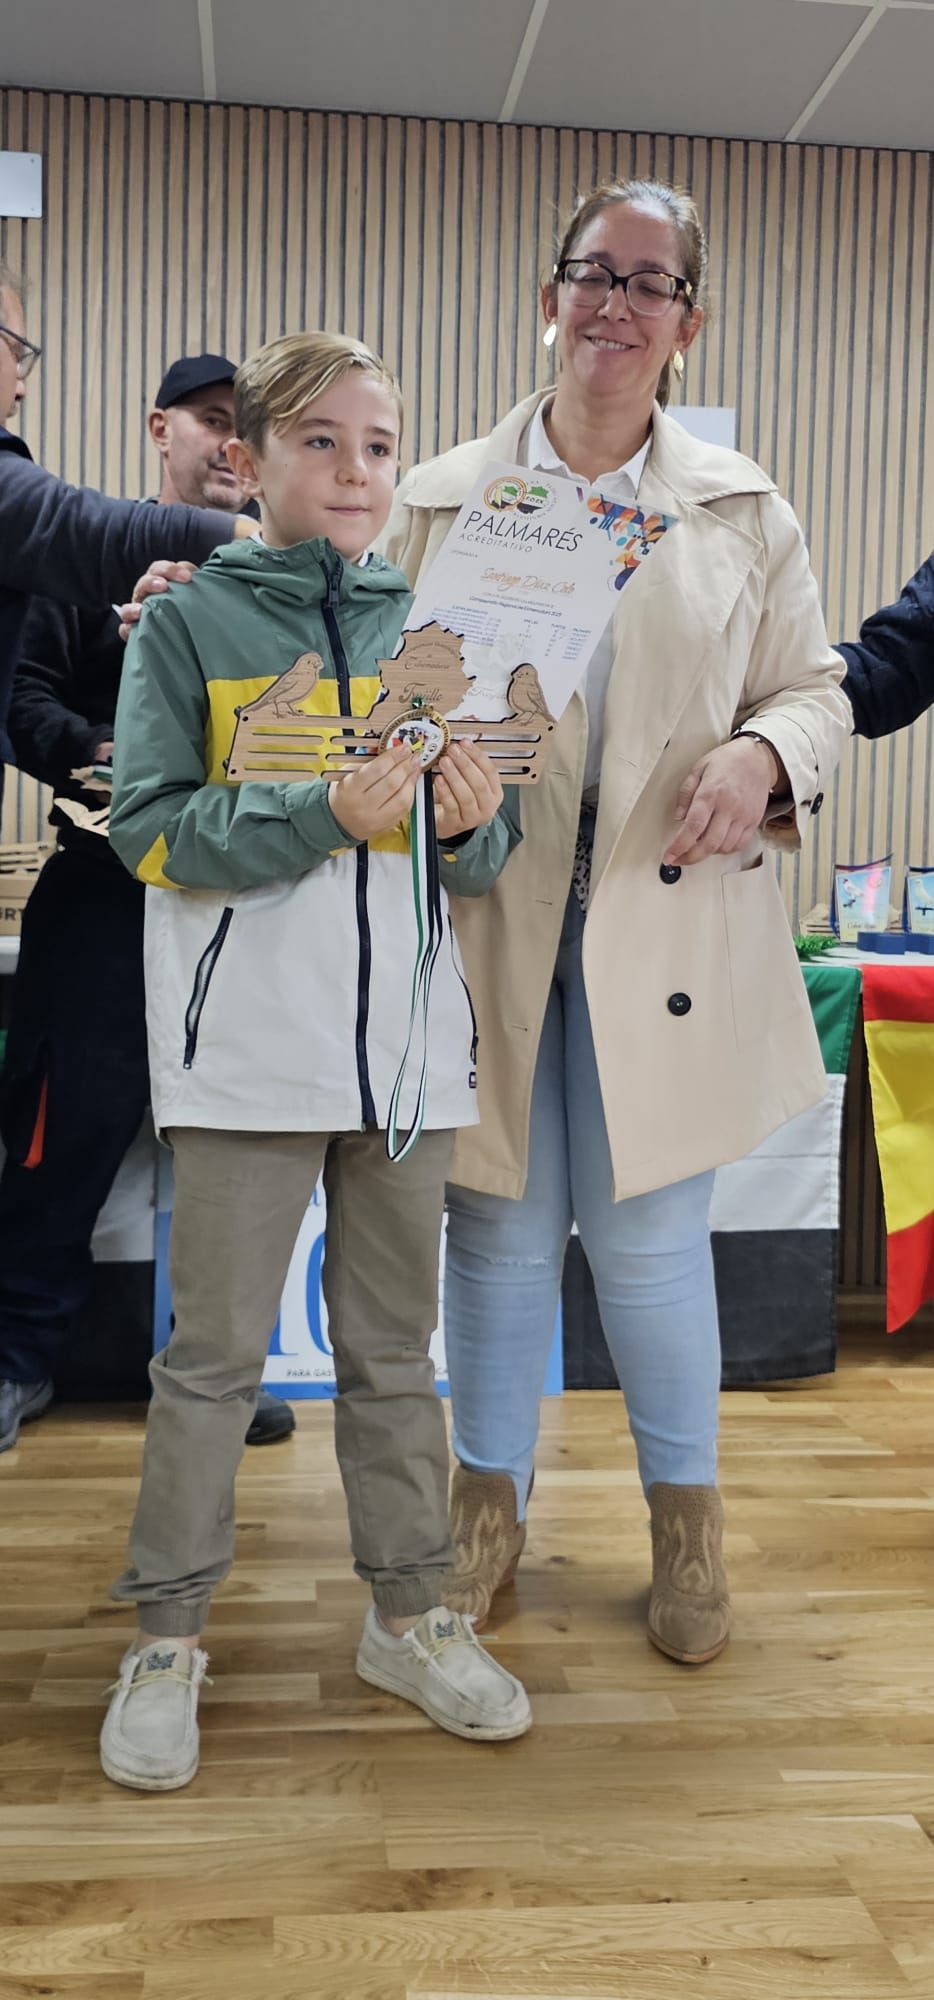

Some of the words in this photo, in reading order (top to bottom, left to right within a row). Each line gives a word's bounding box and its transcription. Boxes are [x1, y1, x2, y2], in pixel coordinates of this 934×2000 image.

[464, 510, 583, 552] PALMARÉS
[459, 533, 533, 553] ACREDITATIVO
[286, 1368, 311, 1377] PARA
